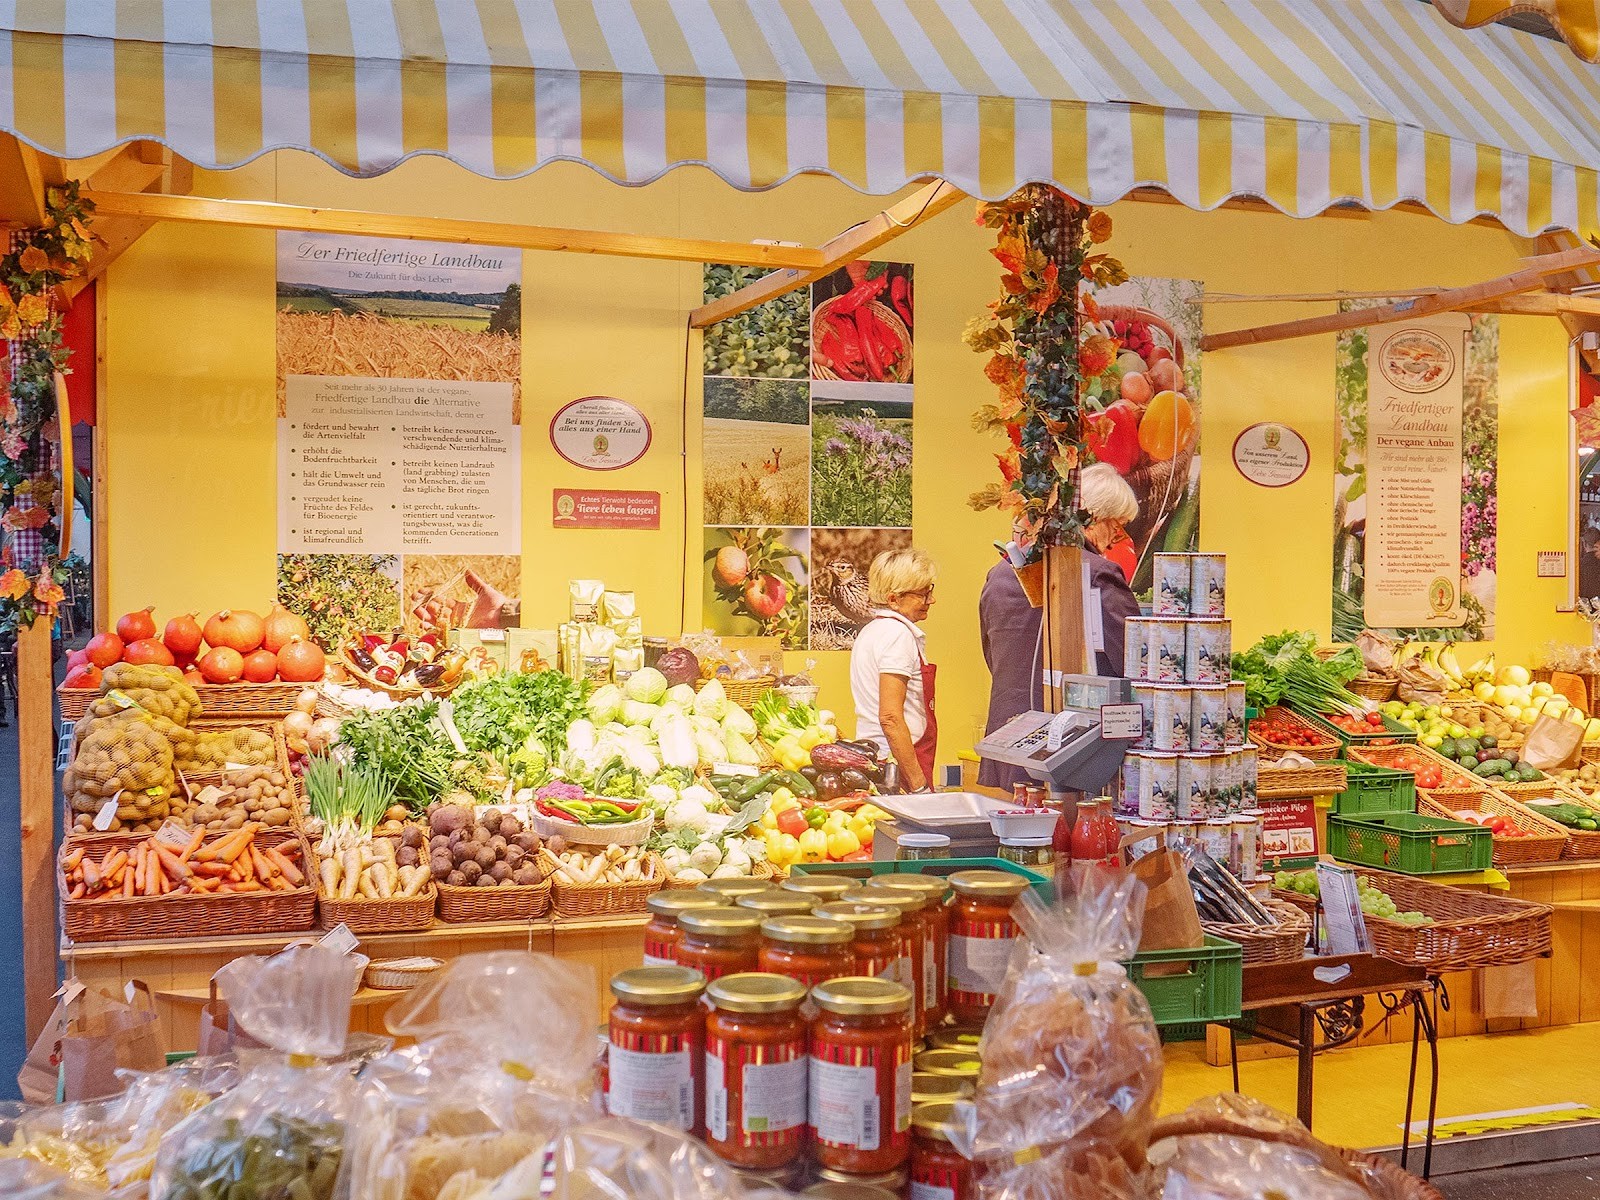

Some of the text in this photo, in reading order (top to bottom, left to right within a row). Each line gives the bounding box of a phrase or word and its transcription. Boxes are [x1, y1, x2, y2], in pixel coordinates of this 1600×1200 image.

[297, 241, 503, 269] Der Friedfertige Landbau
[348, 271, 452, 283] Die Zukunft für das Leben
[364, 384, 375, 392] als
[443, 388, 471, 396] vegane,
[315, 394, 480, 407] Friedfertige Landbau die Alternative
[1380, 396, 1454, 417] Friedfertiger
[396, 409, 452, 418] Landwirtschaft,
[455, 411, 474, 419] denn
[565, 417, 578, 425] Bei
[595, 419, 621, 427] finden
[1388, 414, 1448, 432] Landbau
[303, 422, 379, 432] fördert und bewahrt
[402, 425, 431, 433] betreibt
[433, 426, 454, 434] keine
[316, 432, 366, 440] Artenvielfalt
[402, 434, 504, 444] verschwendende und klima-
[1377, 437, 1454, 448] Der vegane Anbau
[403, 443, 507, 453] schädigende Nutztierhaltung
[303, 456, 377, 464] Bodenfruchtbarkeit
[433, 460, 458, 468] keinen
[460, 460, 495, 469] Landraub
[303, 470, 318, 478] hält
[334, 471, 364, 479] Umwelt
[403, 468, 490, 478] (land grabbing) zulasten
[317, 480, 368, 488] Grundwasser
[370, 480, 385, 488] rein
[418, 477, 459, 485] Menschen,
[417, 486, 446, 494] tägliche
[447, 486, 464, 494] Brot
[466, 486, 490, 495] ringen
[303, 495, 363, 504] vergeudet keine
[602, 496, 626, 504] Tierwohl
[627, 497, 653, 505] bedeutet
[303, 503, 334, 511] Früchte
[335, 503, 348, 511] des
[402, 502, 480, 512] ist gerecht, zukunfts-
[577, 504, 657, 515] Tiere leben lassen!
[317, 512, 358, 521] Bioenergie
[402, 512, 438, 520] orientiert
[403, 520, 455, 529] tungsbewusst,
[472, 520, 483, 528] die
[303, 527, 313, 536] ist
[315, 528, 345, 536] regional
[402, 529, 448, 537] kommenden
[303, 536, 364, 544] klimafreundlich
[403, 537, 432, 545] betrifft.
